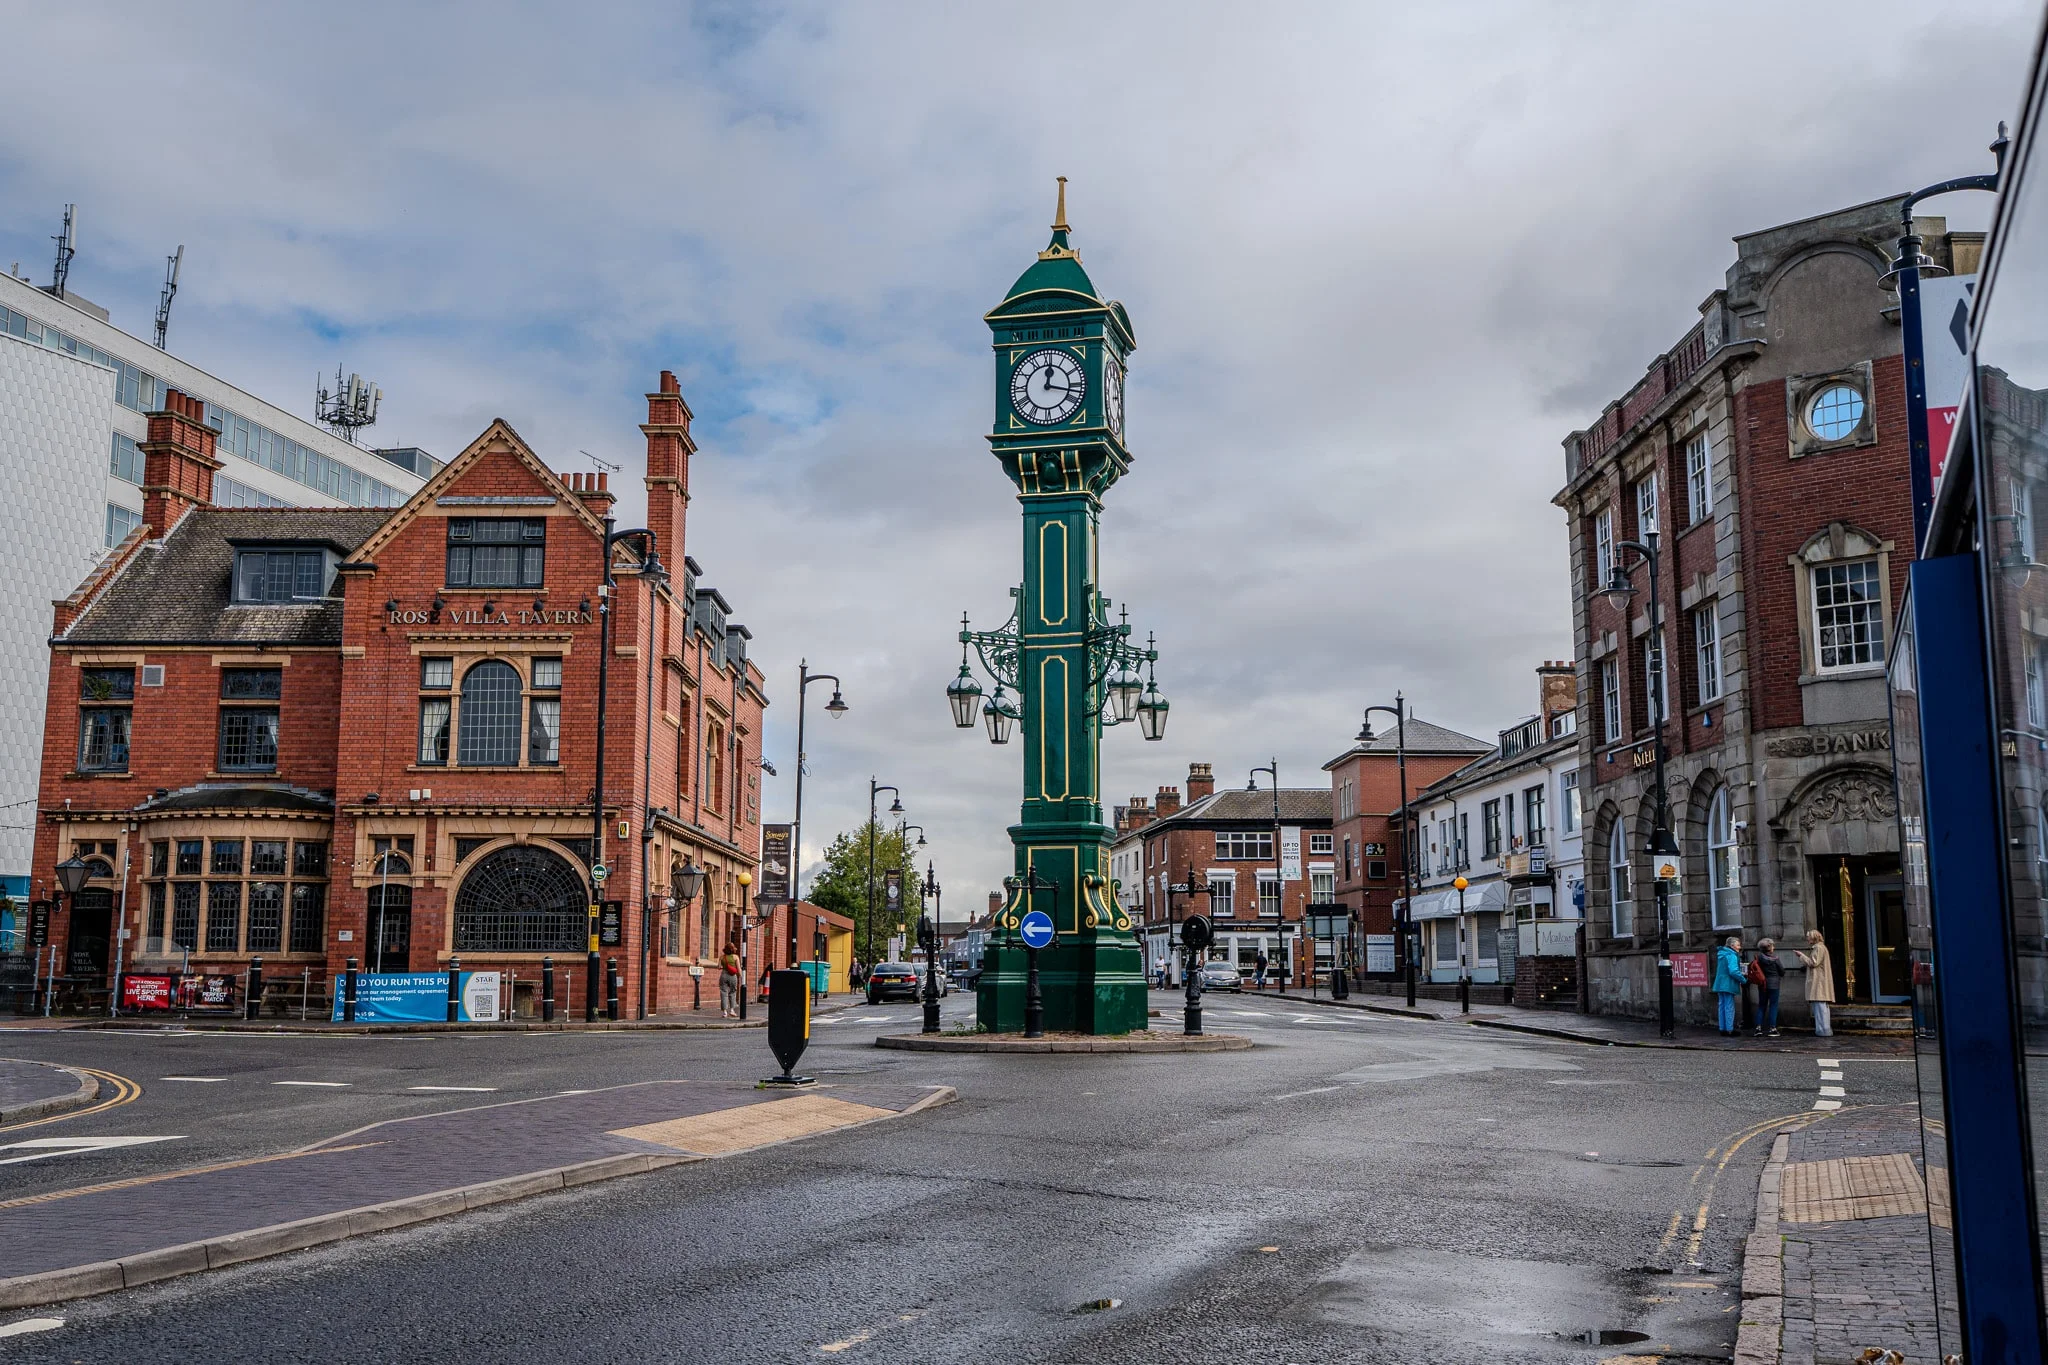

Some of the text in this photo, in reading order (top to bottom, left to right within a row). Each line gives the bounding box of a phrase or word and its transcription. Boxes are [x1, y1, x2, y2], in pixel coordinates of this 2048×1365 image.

[389, 609, 593, 624] ROSE VILLA TAVERN
[1813, 730, 1891, 754] BANK
[1633, 749, 1656, 768] ASTELL
[414, 978, 434, 986] THIS
[437, 977, 450, 986] PU
